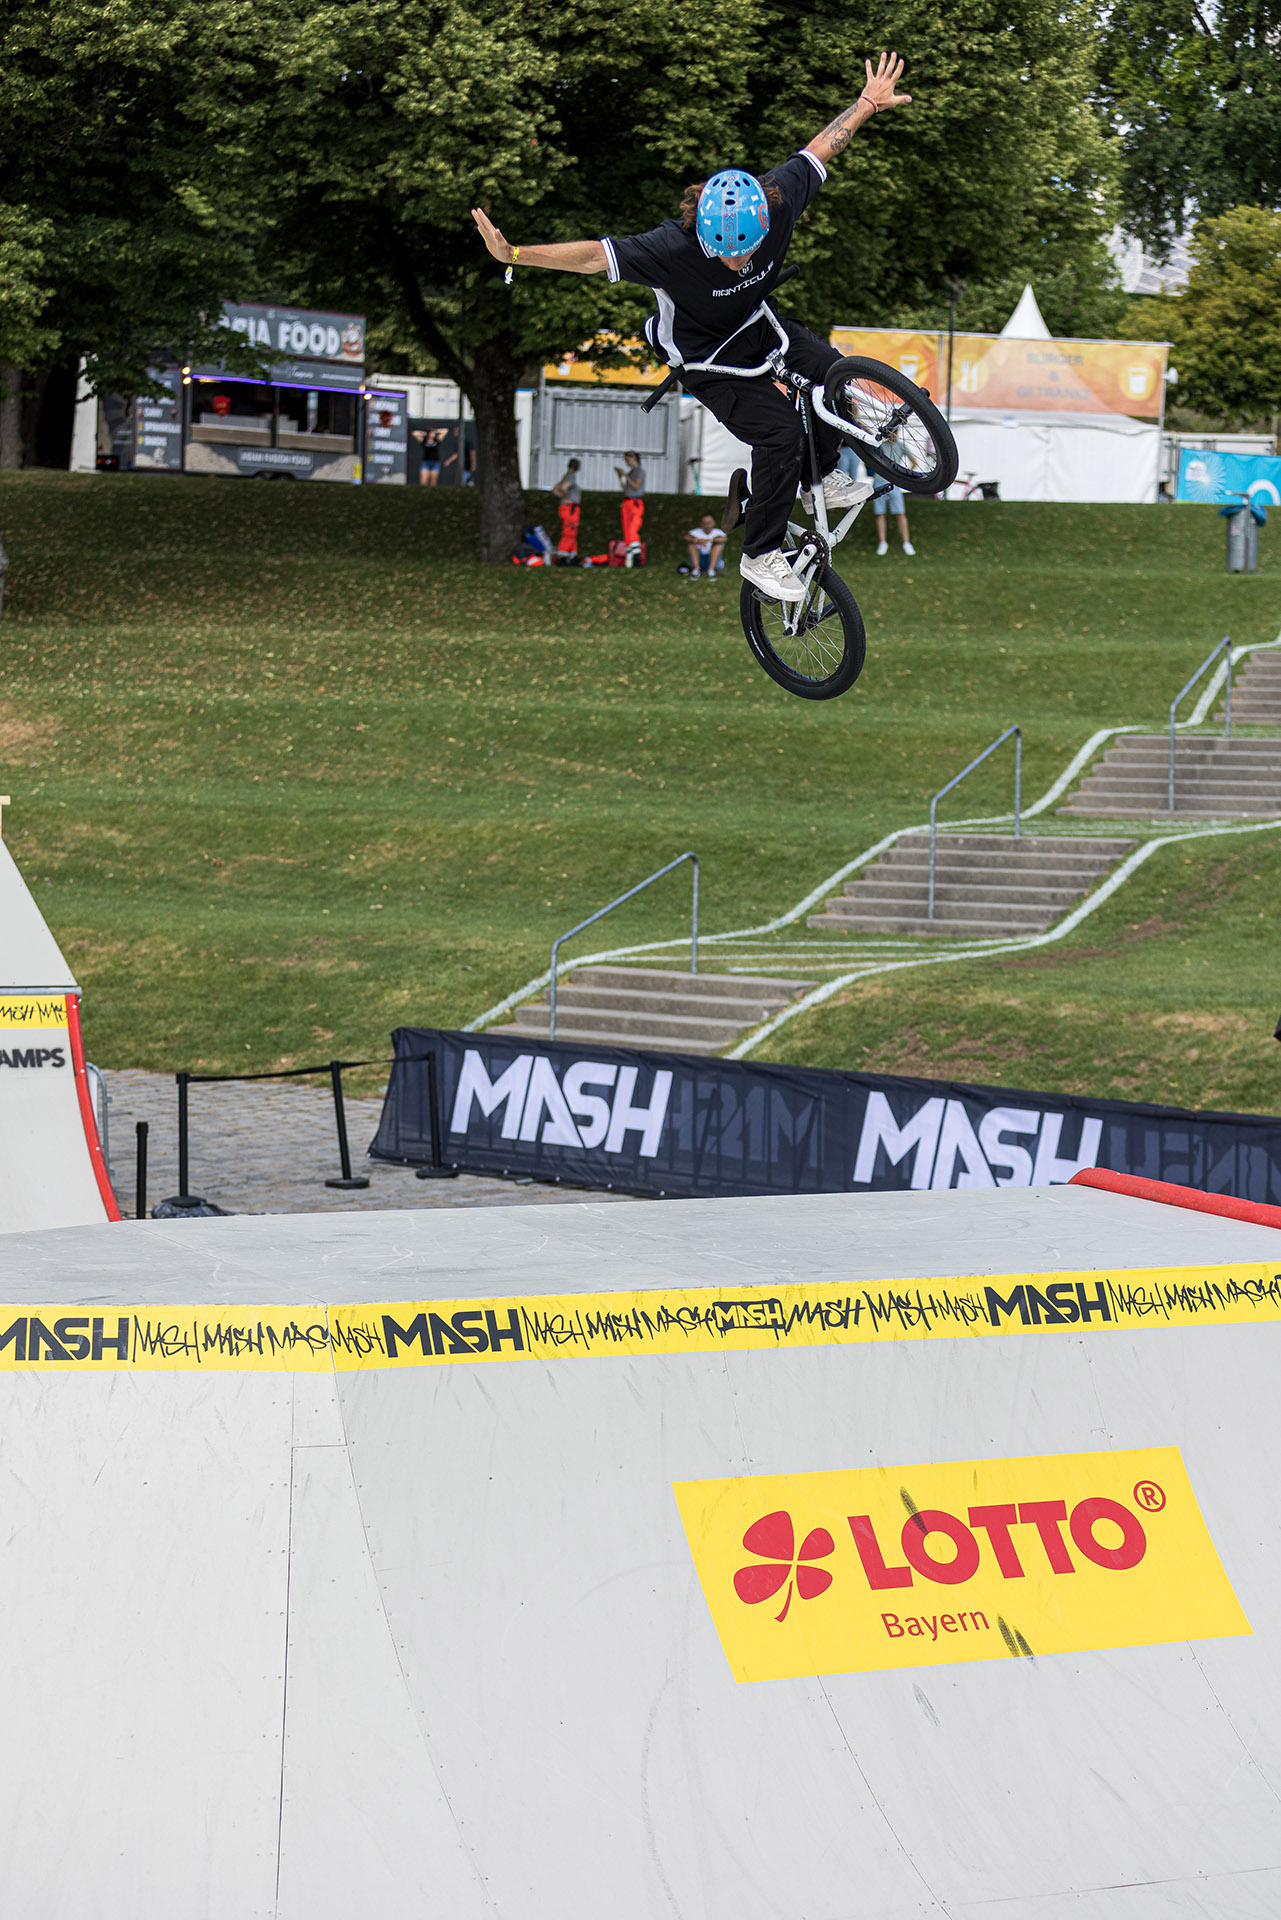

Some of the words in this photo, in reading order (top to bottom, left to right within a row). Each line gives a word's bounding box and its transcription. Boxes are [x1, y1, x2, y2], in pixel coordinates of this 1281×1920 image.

[278, 319, 341, 355] FOOD
[450, 1049, 673, 1158] MASH
[853, 1091, 1103, 1190] MASH
[132, 1315, 201, 1363] MASH
[202, 1321, 264, 1356] MASH
[266, 1320, 330, 1357] MAS
[330, 1319, 384, 1358] MASH
[381, 1308, 525, 1358] MASH
[520, 1305, 590, 1352] MASH
[586, 1307, 643, 1342] MASH
[640, 1305, 714, 1339] MASH
[714, 1302, 785, 1329] MASH
[786, 1297, 866, 1333] MASH
[862, 1289, 938, 1332] MASH
[936, 1290, 989, 1326] MASH
[984, 1281, 1113, 1327] MASH
[1106, 1279, 1169, 1323] MASH
[1164, 1280, 1217, 1312] MASH
[1212, 1278, 1279, 1311] MASH
[848, 1497, 1147, 1591] LOTTO
[881, 1610, 990, 1642] Bayern
